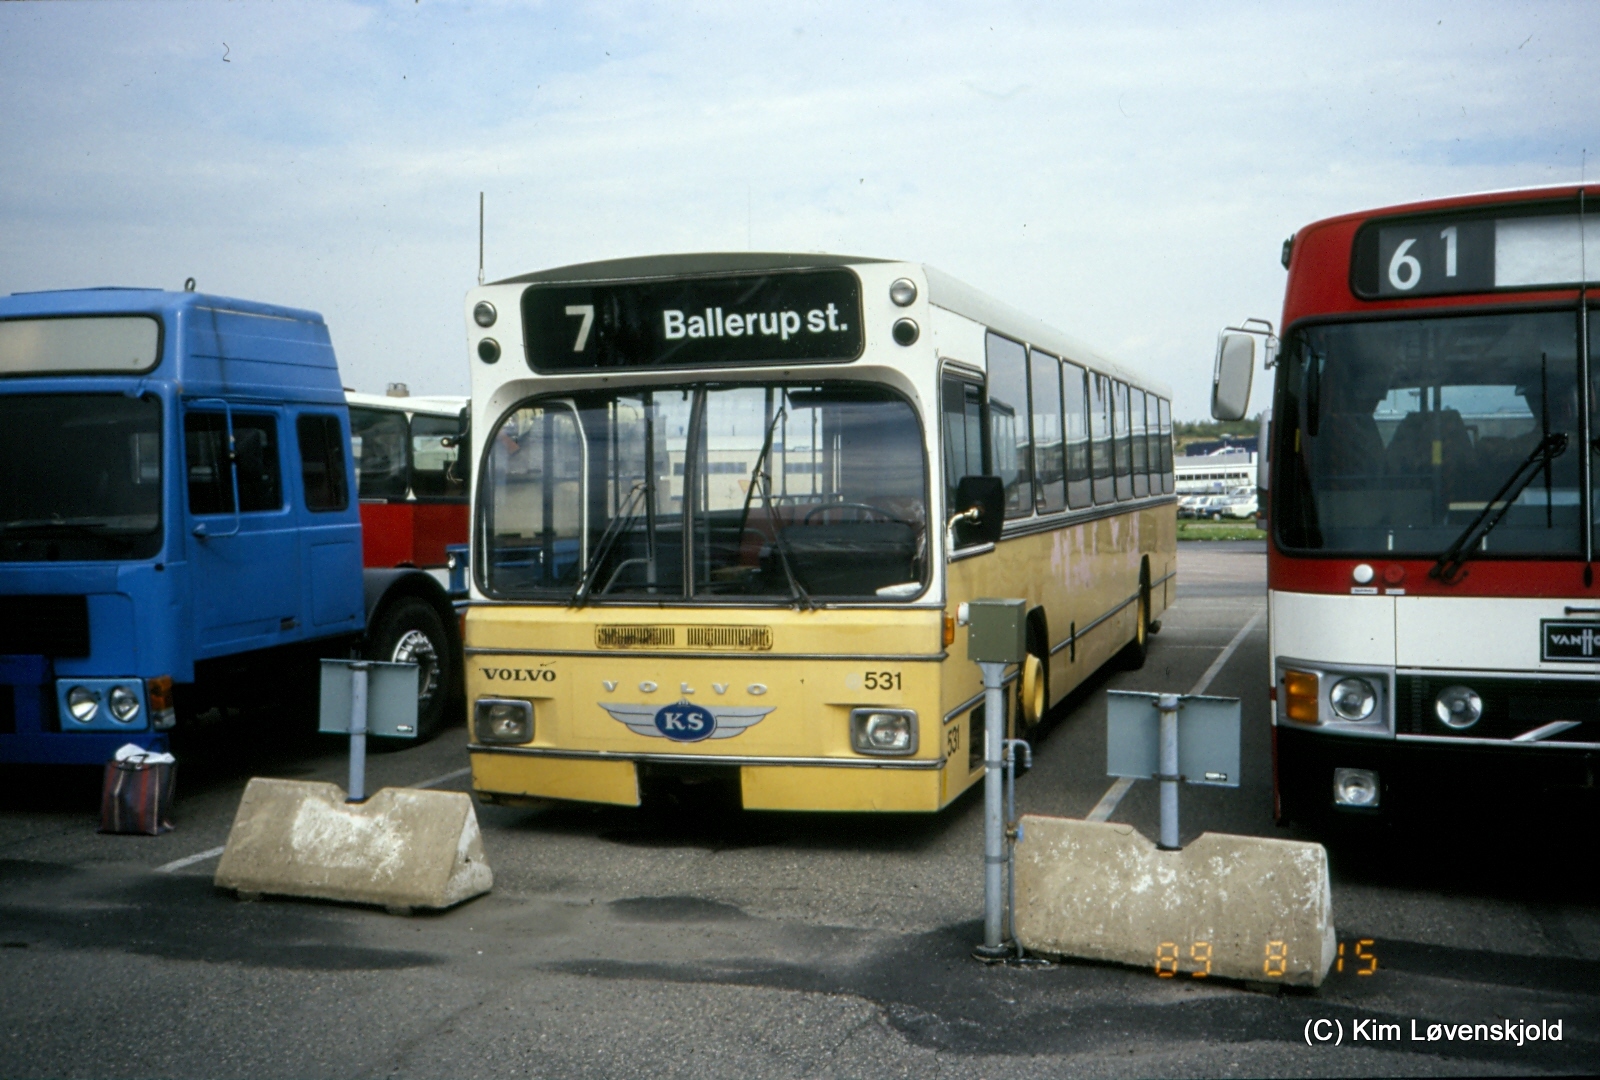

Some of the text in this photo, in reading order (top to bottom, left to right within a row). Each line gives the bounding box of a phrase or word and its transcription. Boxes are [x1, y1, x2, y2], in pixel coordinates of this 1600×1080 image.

[1388, 226, 1457, 291] 61
[565, 304, 595, 352] 7
[663, 303, 848, 341] Ballerup st.
[482, 667, 556, 683] VOLVO
[602, 680, 768, 695] VOLVO
[864, 671, 902, 690] 531
[664, 712, 705, 731] KS
[947, 724, 960, 757] 531
